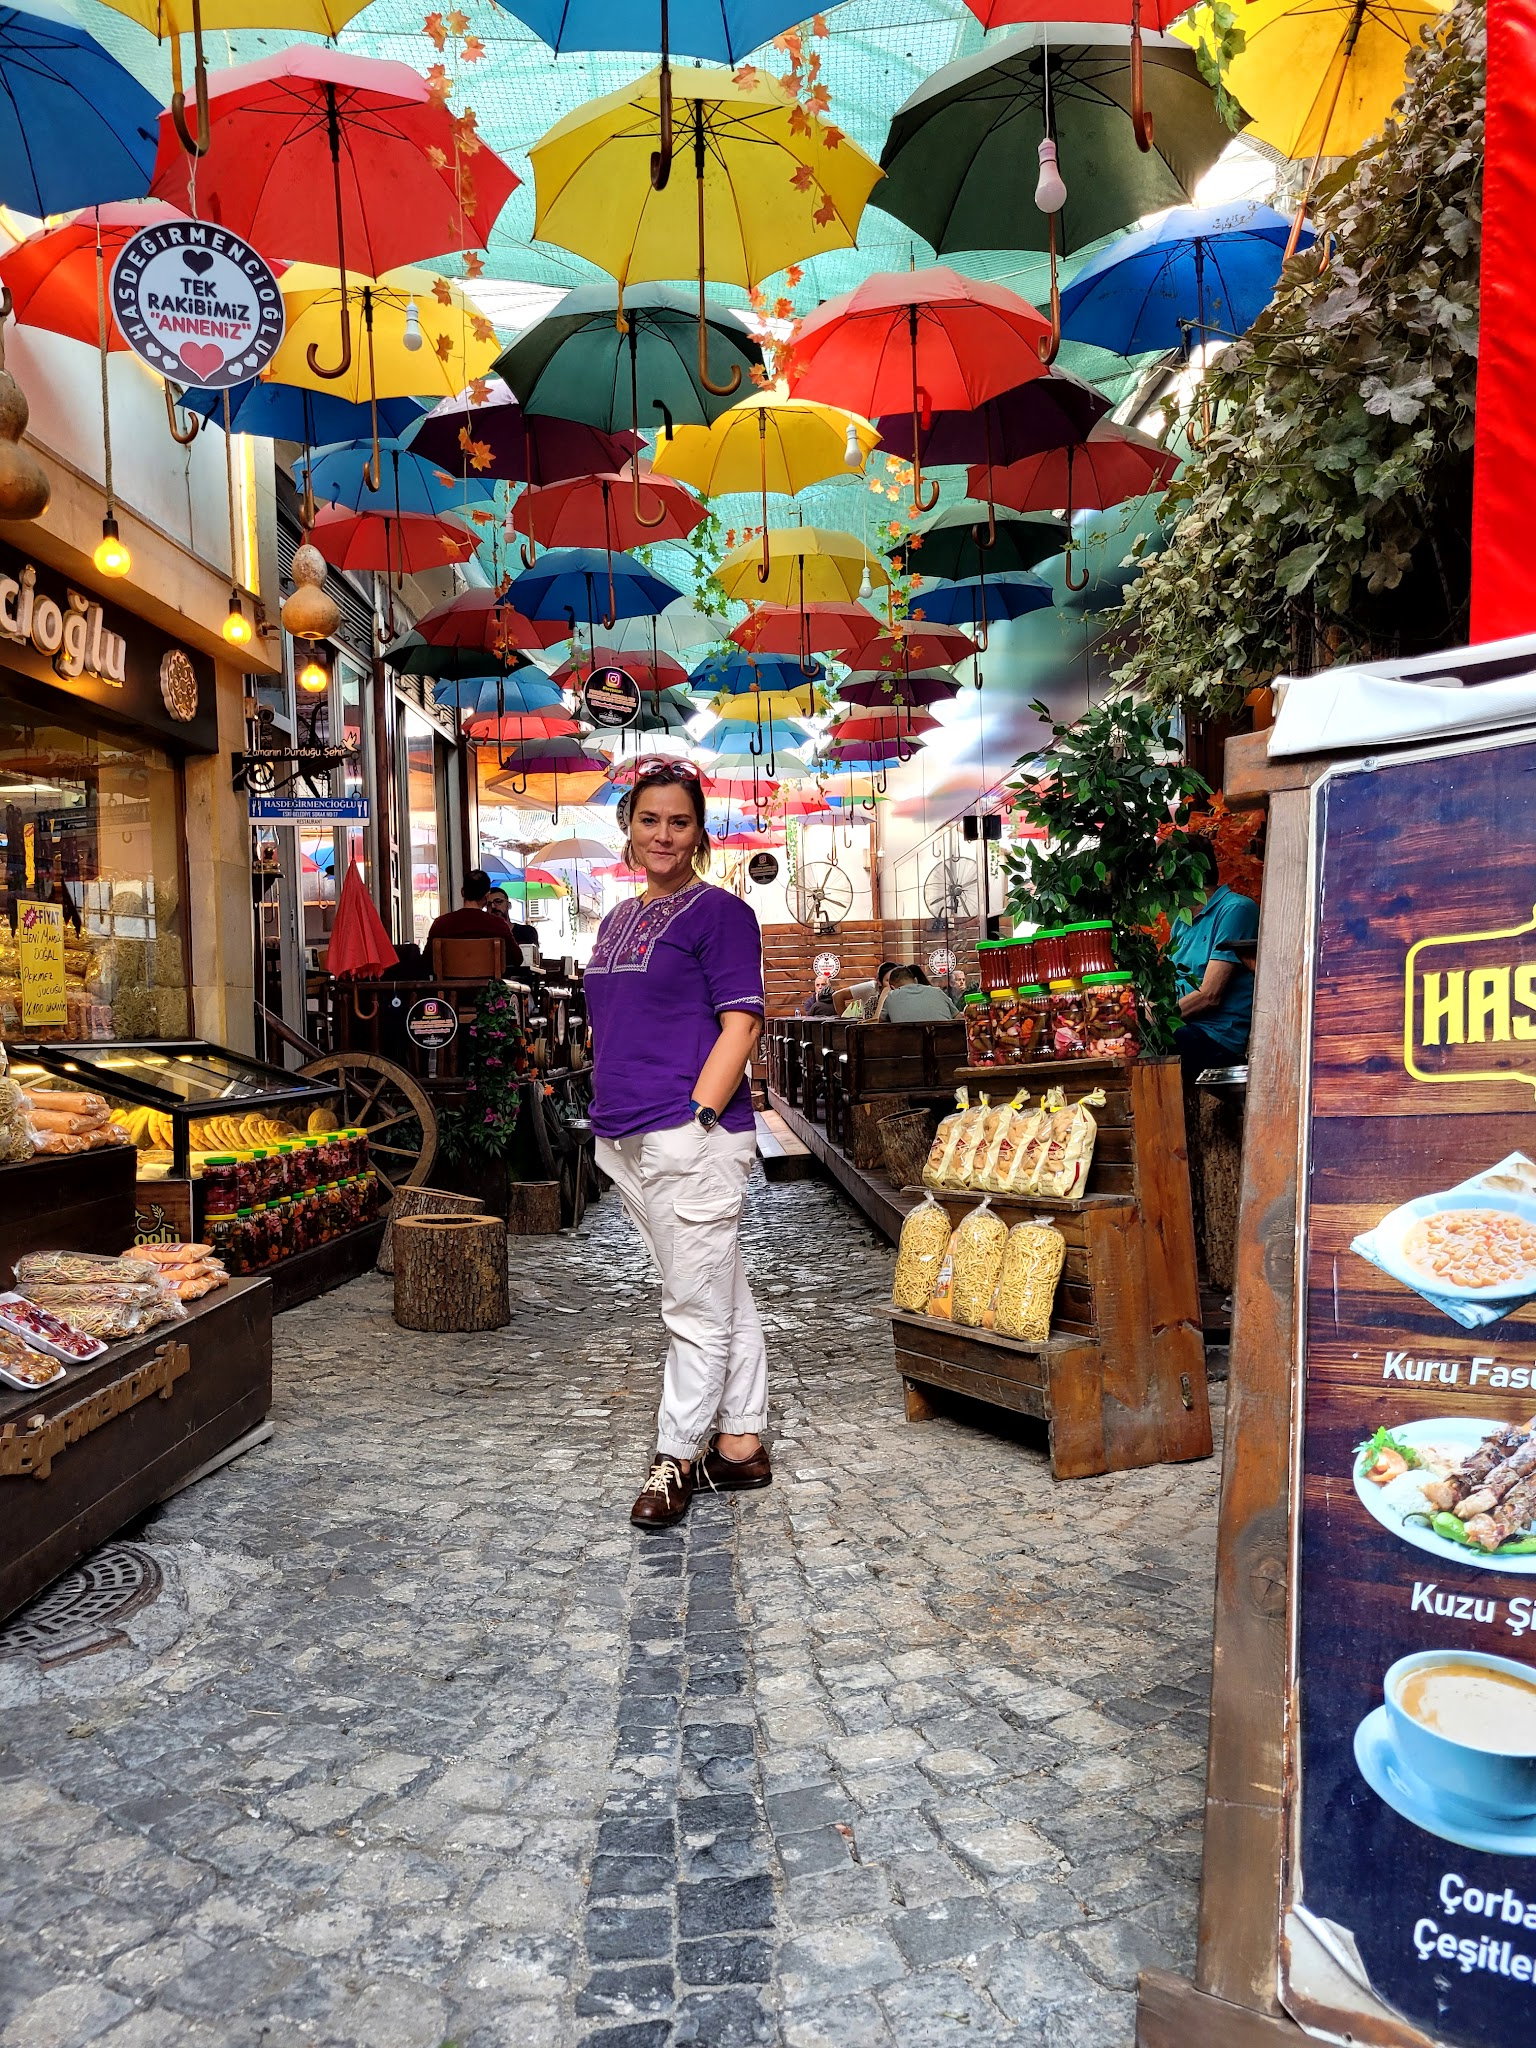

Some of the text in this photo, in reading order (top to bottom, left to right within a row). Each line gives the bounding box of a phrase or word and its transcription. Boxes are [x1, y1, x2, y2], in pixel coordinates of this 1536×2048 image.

[180, 277, 217, 299] TEK
[244, 746, 346, 759] Zamanın Durduğu Şehir
[1422, 964, 1536, 1046] HAS
[1382, 1351, 1536, 1390] Kuru Fas
[1410, 1581, 1496, 1624] Kuzu
[1439, 1872, 1536, 1931] Çorba
[1413, 1917, 1536, 1986] Çeşitle
